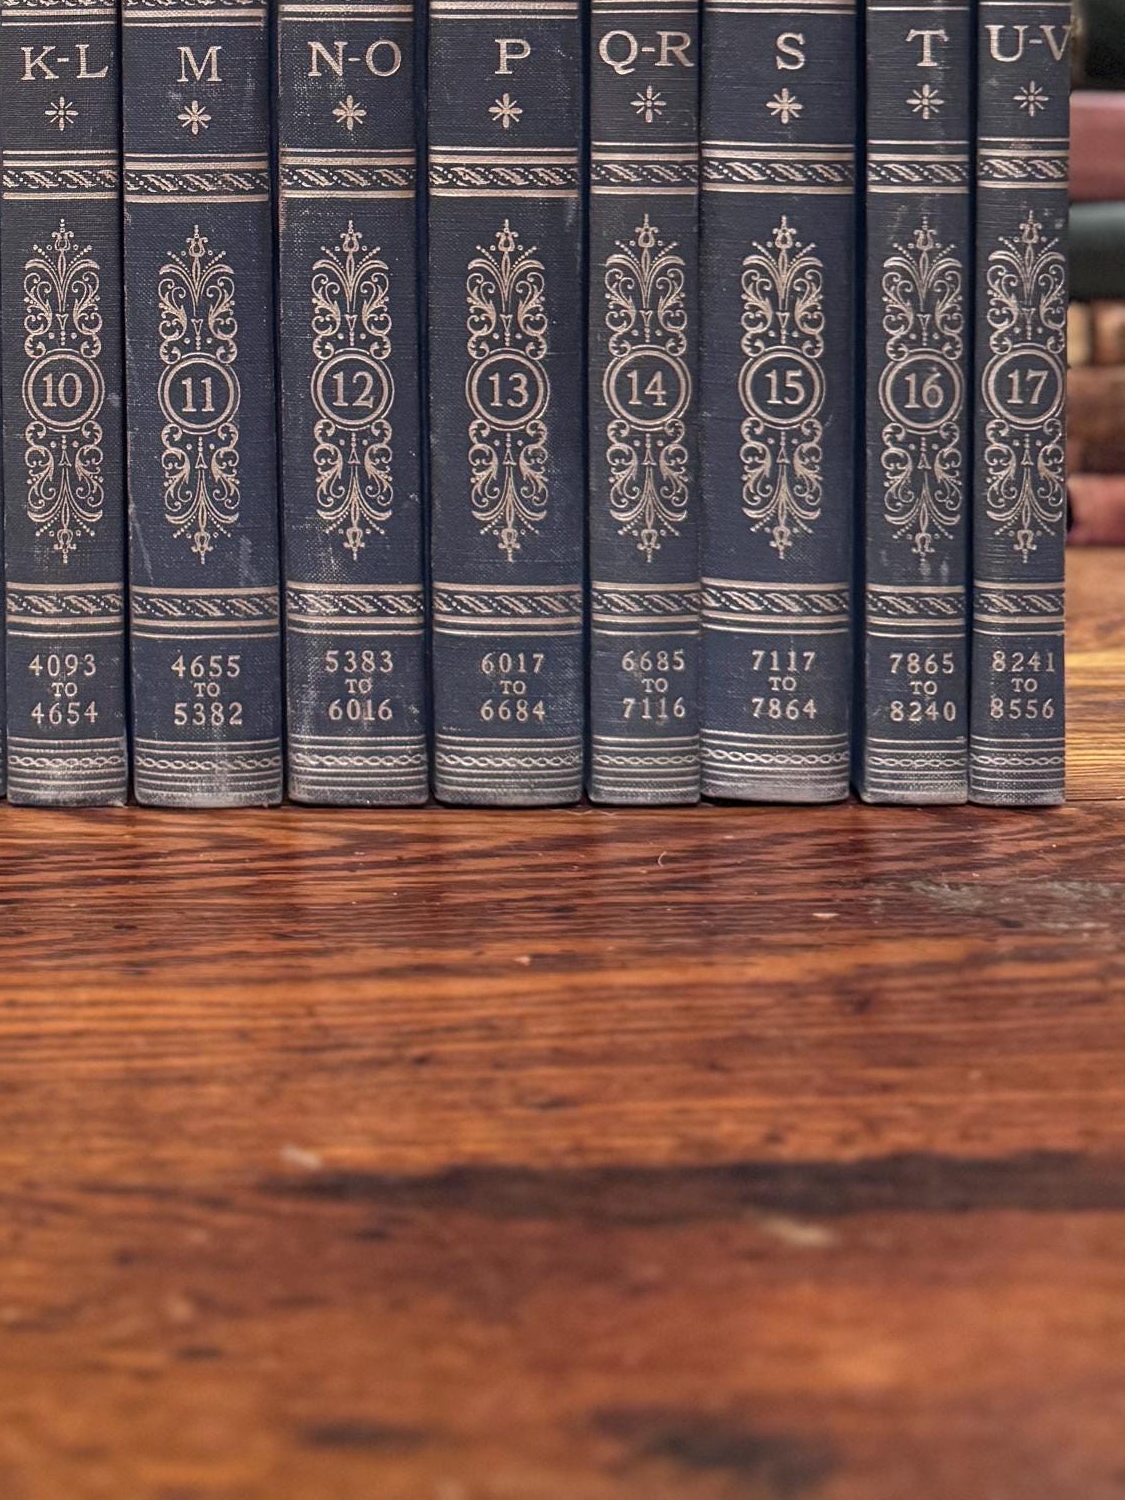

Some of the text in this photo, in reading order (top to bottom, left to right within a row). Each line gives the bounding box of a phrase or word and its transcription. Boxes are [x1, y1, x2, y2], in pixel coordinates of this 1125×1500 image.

[599, 30, 693, 74] Q-R
[776, 33, 805, 69] S
[906, 29, 948, 66] T
[985, 25, 1070, 62] U-V
[21, 44, 108, 80] K-L
[177, 46, 222, 82] M
[308, 41, 401, 76] N-O
[495, 39, 531, 74] P
[43, 373, 82, 407] 10
[182, 377, 214, 411] 11
[333, 372, 373, 408] 12
[489, 373, 528, 407] 13
[627, 370, 666, 405] 14
[766, 370, 804, 404] 15
[905, 373, 943, 408] 16
[1007, 370, 1047, 404] 17
[29, 654, 95, 676] 4093
[171, 655, 240, 678] 4655
[325, 651, 393, 673] 5383
[482, 653, 543, 674] 6017
[622, 650, 684, 671] 6685
[752, 650, 815, 671] 7117
[890, 653, 953, 674] 7865
[992, 651, 1054, 672] 8241
[52, 683, 77, 698] TO
[346, 678, 372, 693] TO
[642, 678, 667, 692] TO
[910, 681, 937, 694] TO
[32, 702, 98, 724] 4654
[174, 702, 242, 726] 5382
[329, 699, 392, 720] 6016
[481, 699, 545, 721] 6684
[623, 697, 685, 719] 7116
[752, 698, 816, 720] 7864
[891, 701, 955, 721] 8240
[991, 694, 1053, 719] 8556
